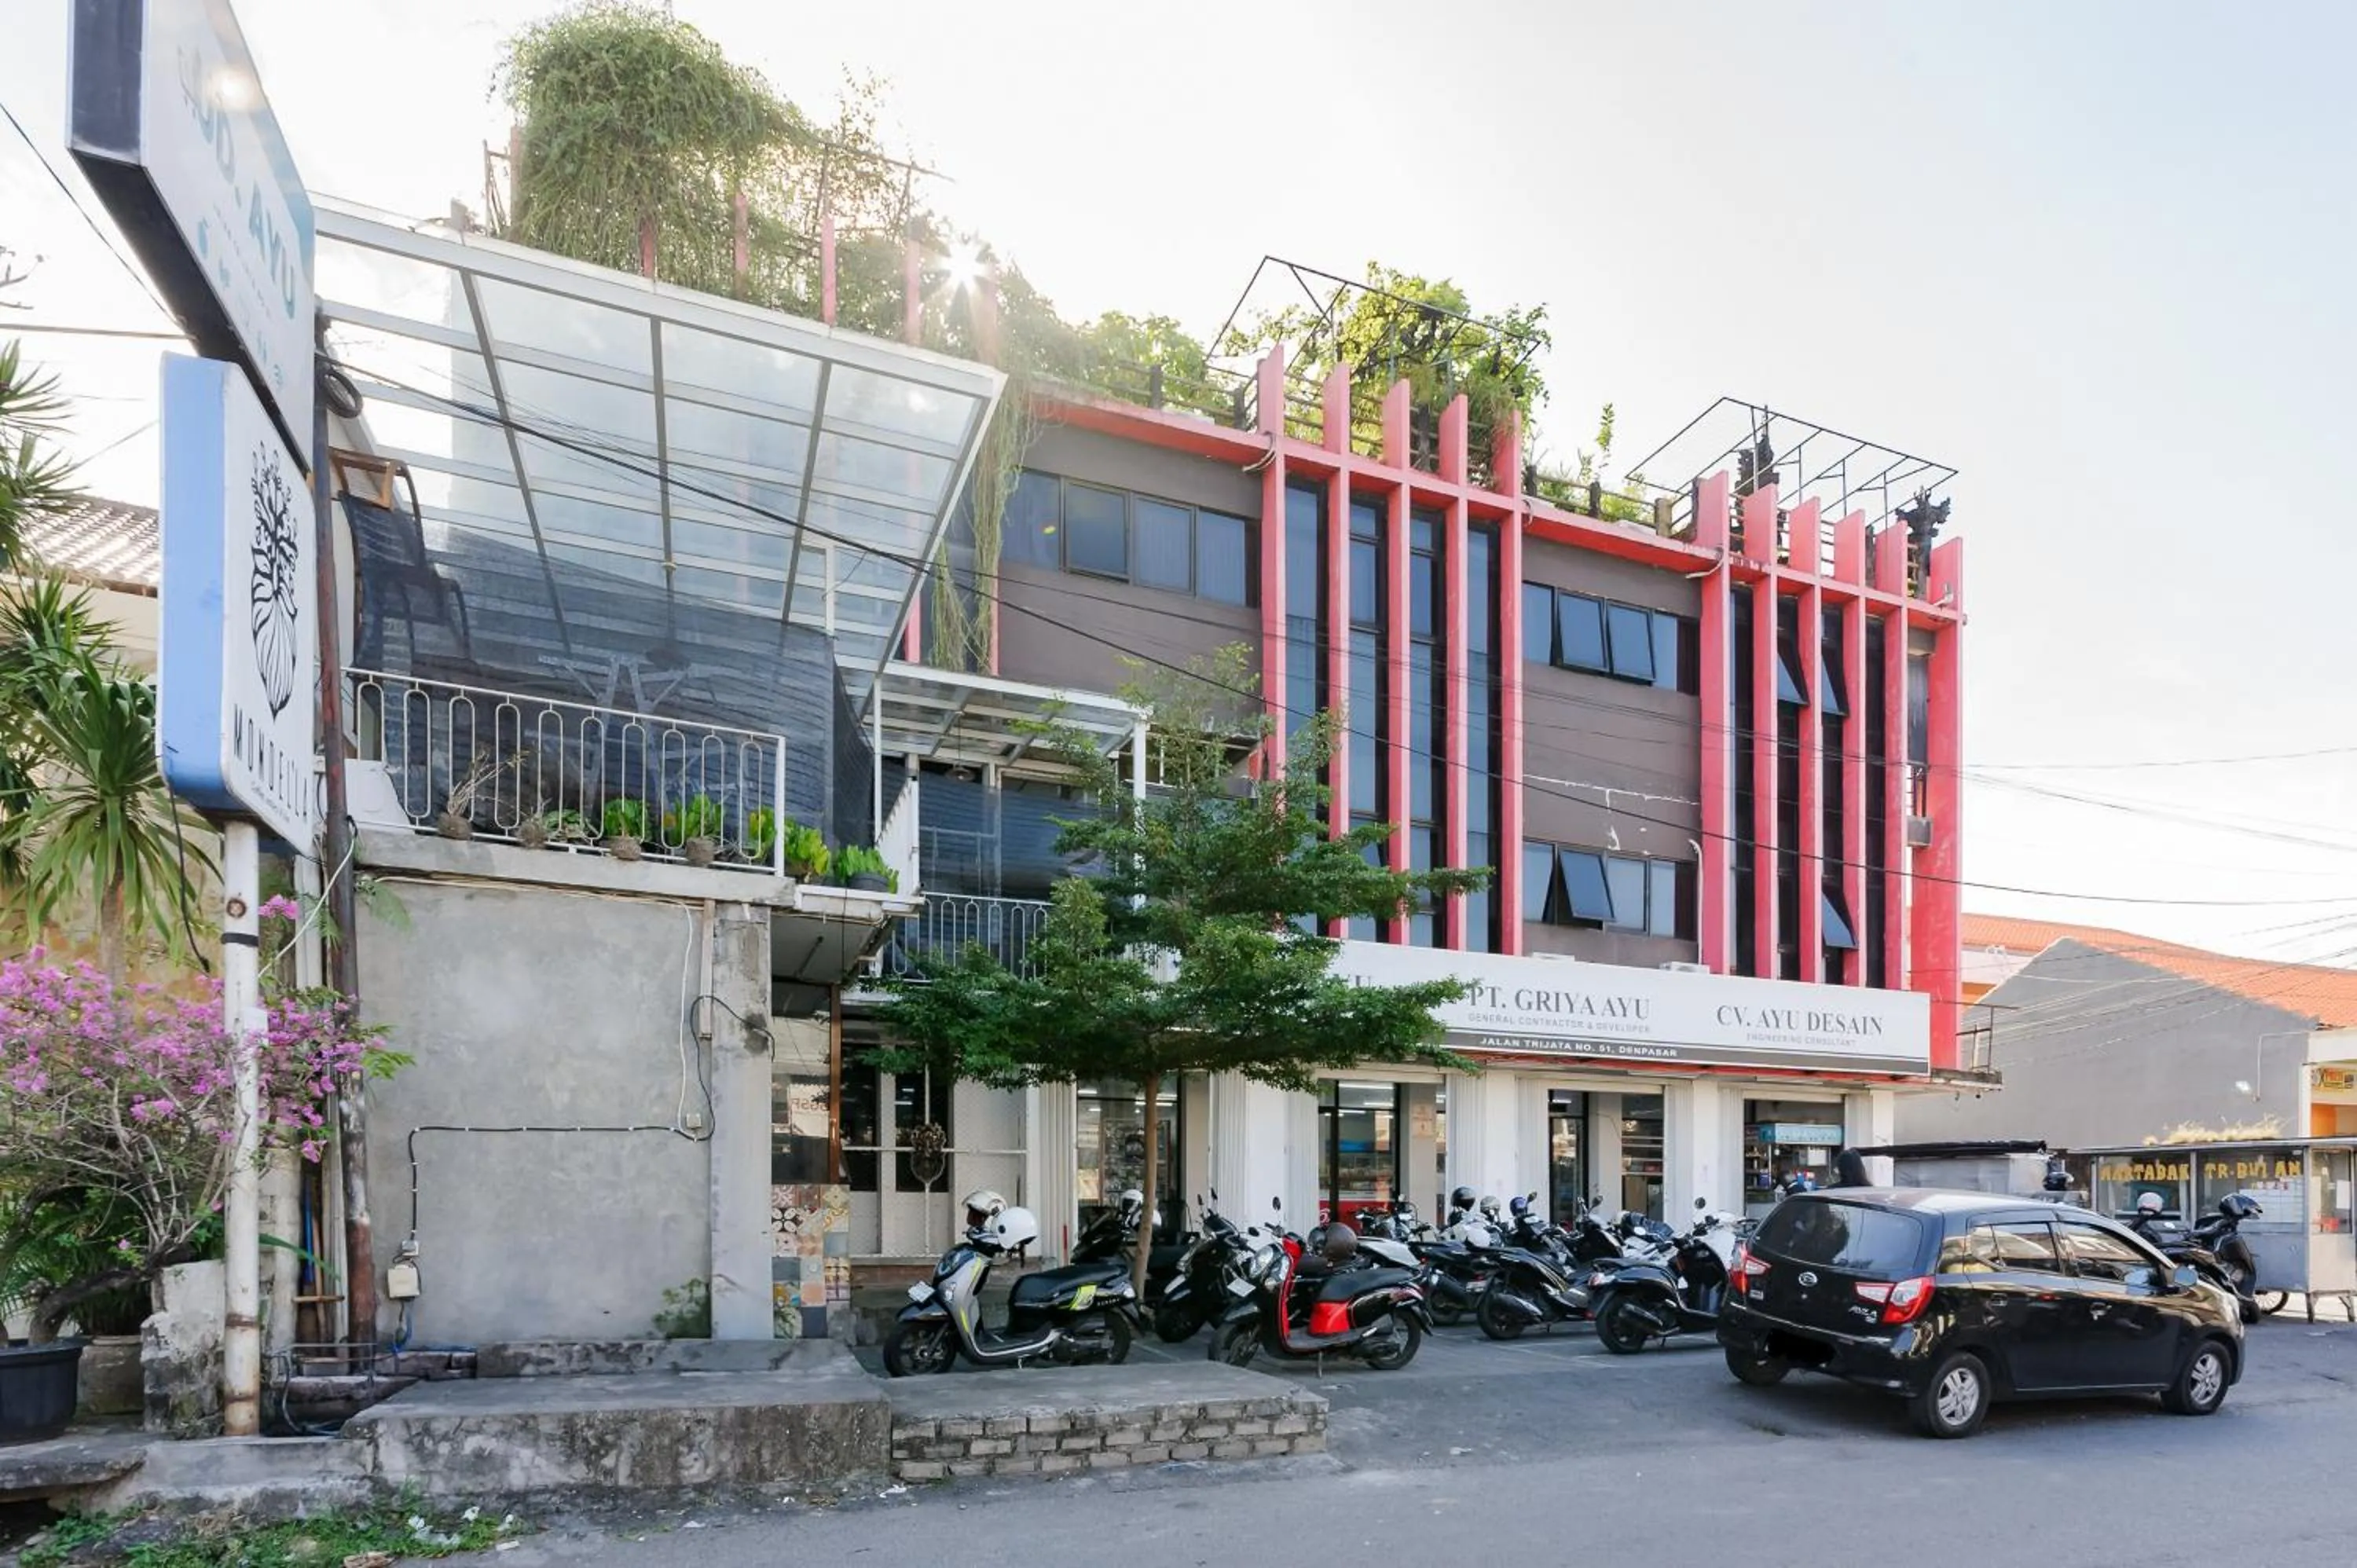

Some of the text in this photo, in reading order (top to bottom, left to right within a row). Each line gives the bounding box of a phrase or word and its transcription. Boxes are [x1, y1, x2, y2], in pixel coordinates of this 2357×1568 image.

[249, 181, 295, 320] AYU
[1470, 986, 1506, 1009] PT.
[1716, 1005, 1883, 1035] CV. AYU DESAIN
[1479, 1038, 1520, 1047] JALAN
[1524, 1040, 1572, 1050] TRIJATA
[1575, 1043, 1596, 1052] NO.
[1618, 1046, 1677, 1057] DENPASAR
